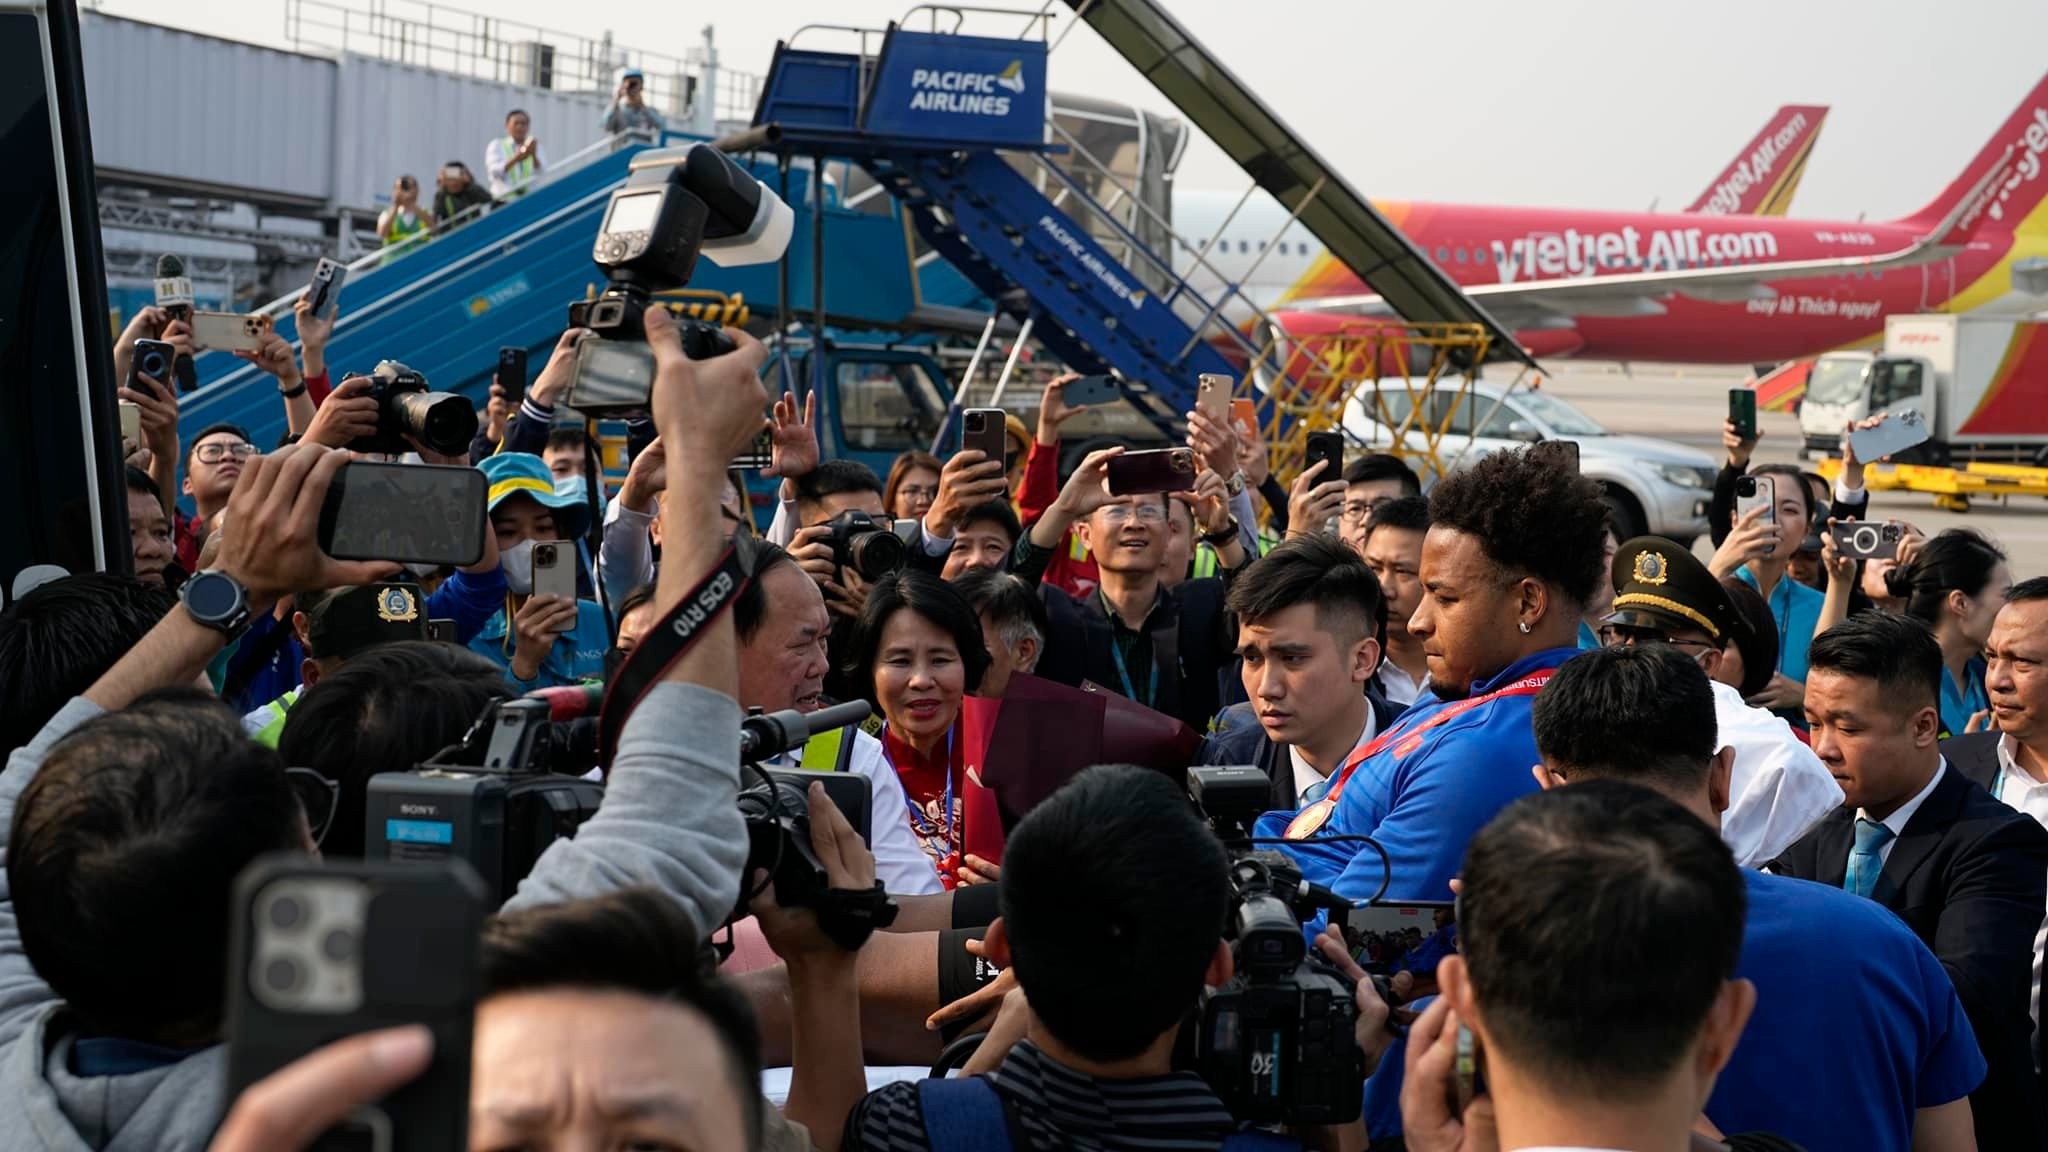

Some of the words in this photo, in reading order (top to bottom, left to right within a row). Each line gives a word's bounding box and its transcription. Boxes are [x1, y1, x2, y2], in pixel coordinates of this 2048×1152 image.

[911, 69, 996, 93] PACIFIC
[910, 91, 1011, 116] AIRLINES
[1040, 215, 1084, 256] PACIFIC
[1080, 252, 1131, 299] AIRLINES
[699, 571, 733, 611] EOS
[673, 603, 706, 637] R10
[401, 804, 438, 815] SONY
